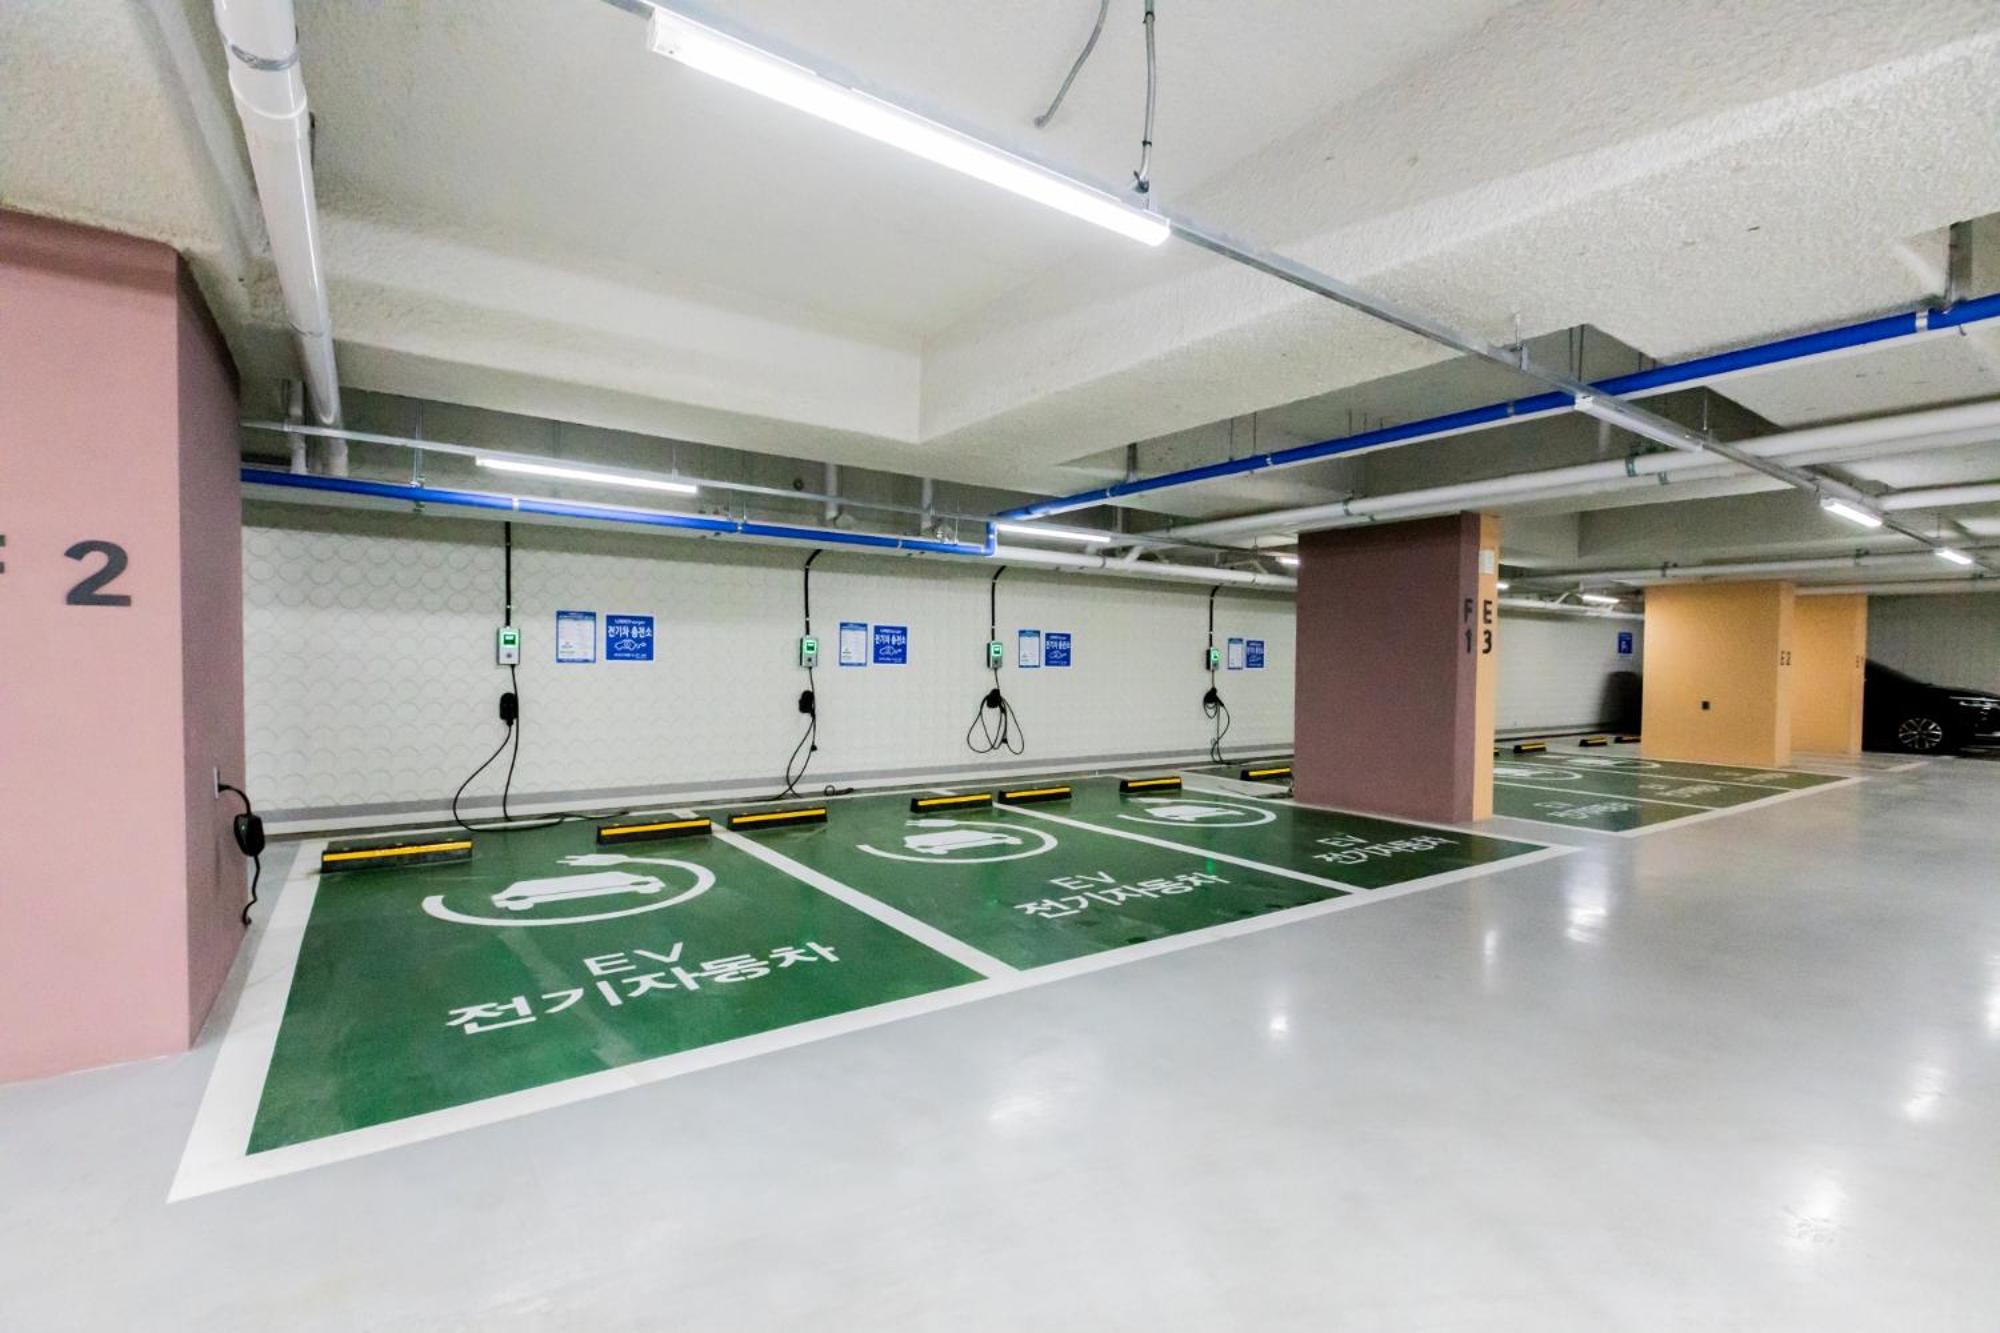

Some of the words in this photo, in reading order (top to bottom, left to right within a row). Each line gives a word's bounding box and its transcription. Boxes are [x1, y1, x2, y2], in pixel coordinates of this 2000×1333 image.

[64, 540, 132, 607] 2
[1014, 872, 1231, 919] 전기자동차
[1050, 871, 1116, 891] EV
[583, 941, 684, 977] EV
[446, 941, 840, 1035] 전기자동차
